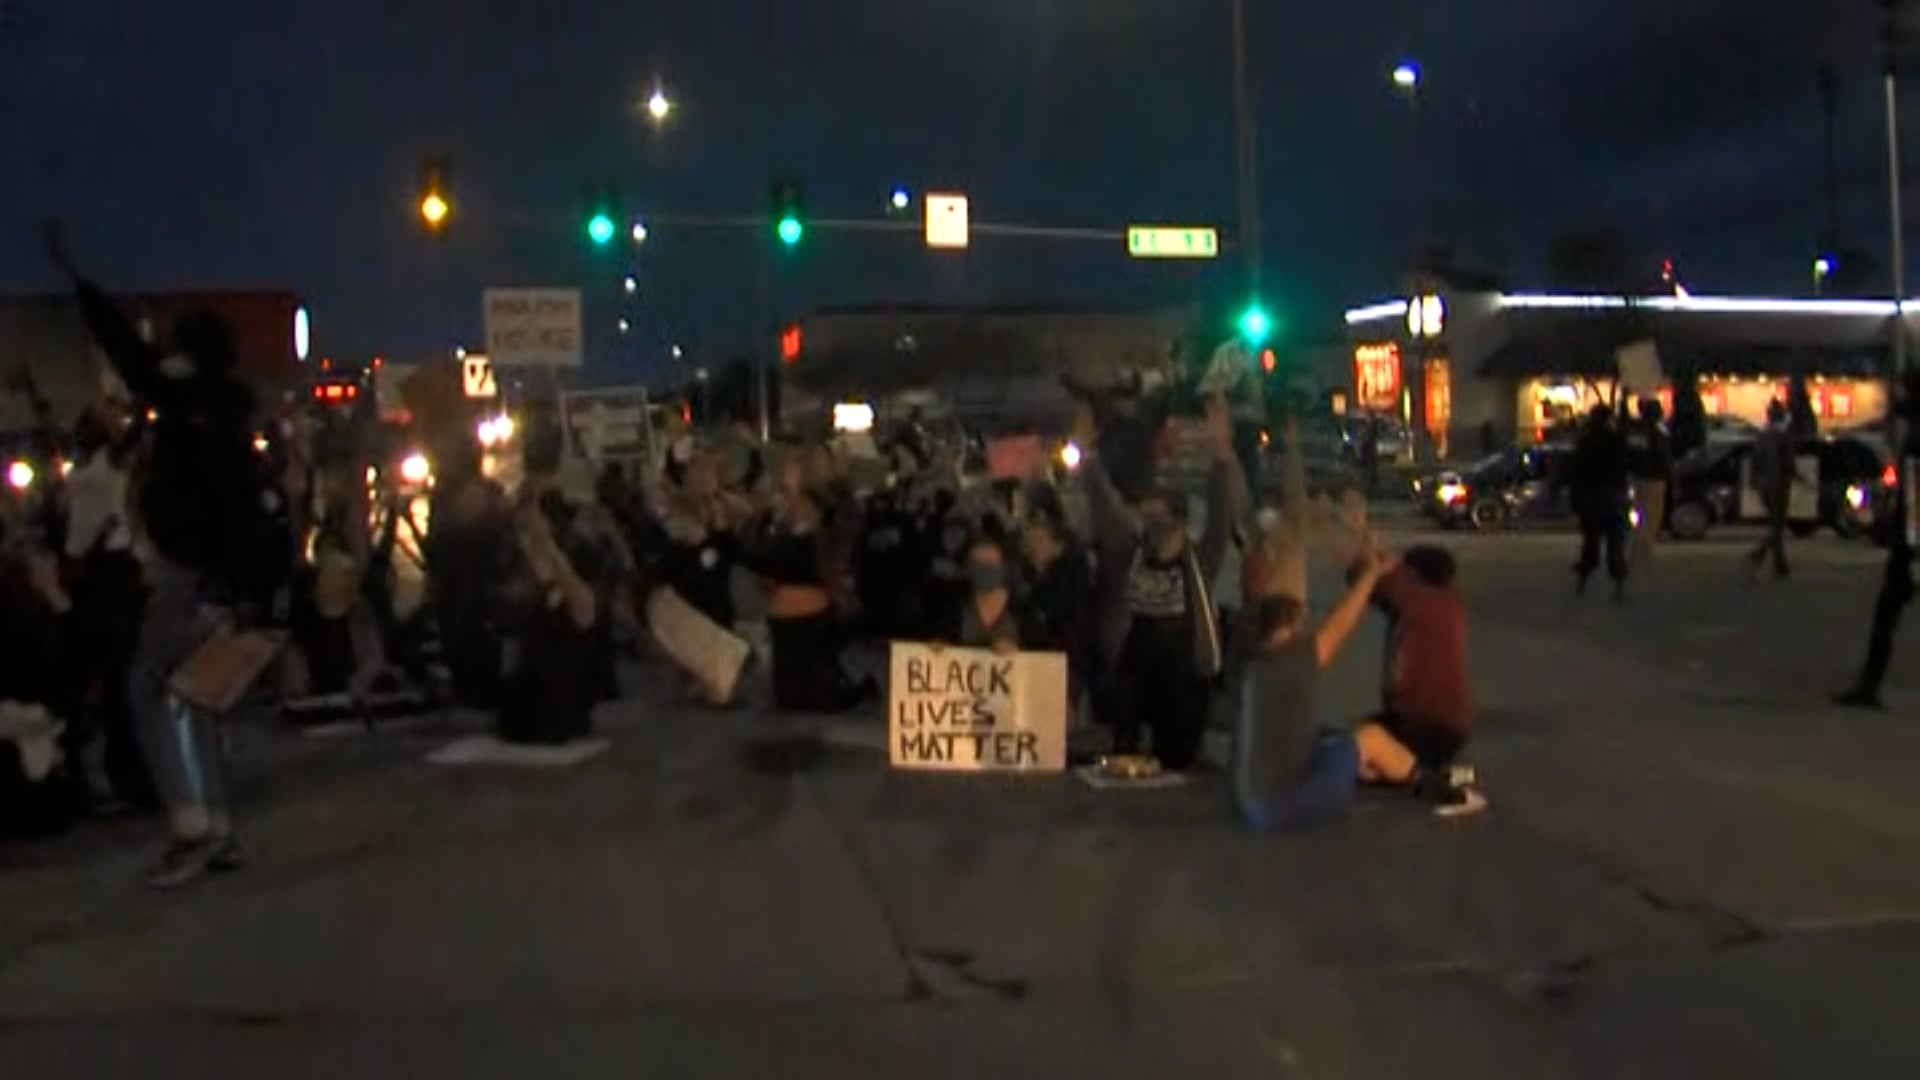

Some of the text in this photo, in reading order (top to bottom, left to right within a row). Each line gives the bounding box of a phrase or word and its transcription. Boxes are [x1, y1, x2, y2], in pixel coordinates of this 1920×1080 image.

[907, 657, 1013, 694] BLACK
[900, 700, 995, 727] LIVES
[901, 732, 1038, 765] MATTER
